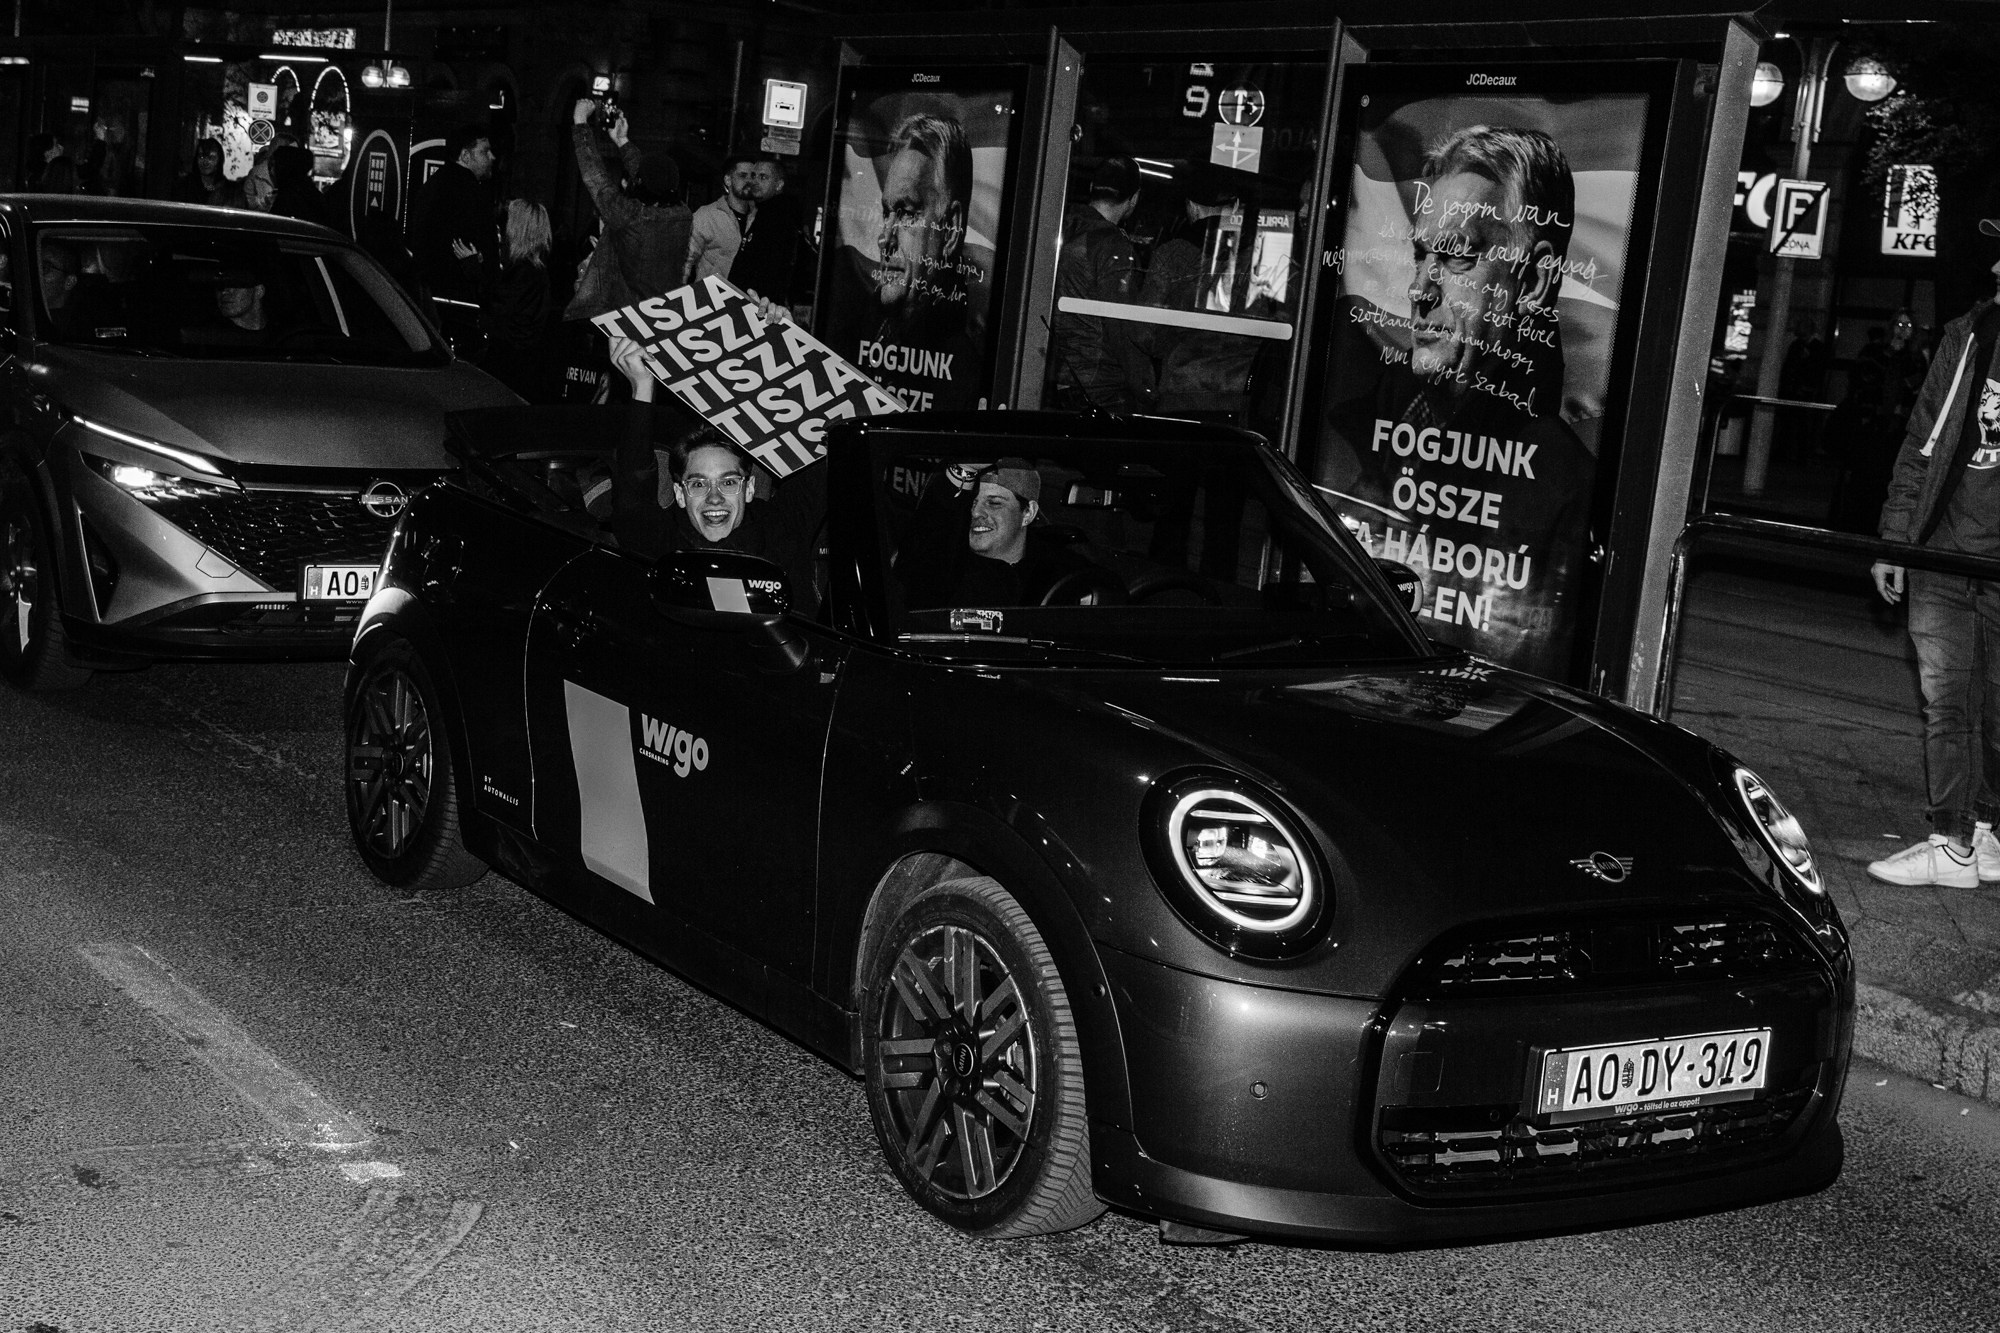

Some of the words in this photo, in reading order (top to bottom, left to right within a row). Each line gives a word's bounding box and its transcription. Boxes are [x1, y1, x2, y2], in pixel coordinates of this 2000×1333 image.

[911, 73, 940, 83] JCDecaux
[1466, 73, 1517, 86] JCDecaux
[1413, 181, 1434, 215] De
[1510, 204, 1570, 227] van
[1733, 171, 1777, 229] FC
[1892, 233, 1936, 250] KFC
[591, 274, 745, 340] TISZA
[646, 303, 767, 381] TISZA
[858, 339, 954, 381] FOGJUNK
[580, 368, 597, 384] VAN
[668, 325, 827, 413] TISZA
[709, 357, 865, 445] TISZA
[1372, 419, 1538, 480] FOGJUNK
[1393, 466, 1503, 529] ÖSSZE
[1383, 523, 1532, 590] HÁBORÚ
[327, 571, 359, 596] AO
[747, 580, 782, 593] wigo
[1397, 582, 1414, 594] wigo
[641, 713, 710, 778] wigo
[483, 784, 519, 806] AUTOWALLIS
[484, 775, 492, 784] BY
[1547, 1088, 1560, 1106] H
[1572, 1053, 1620, 1105] AO
[1614, 1103, 1638, 1115] wigo
